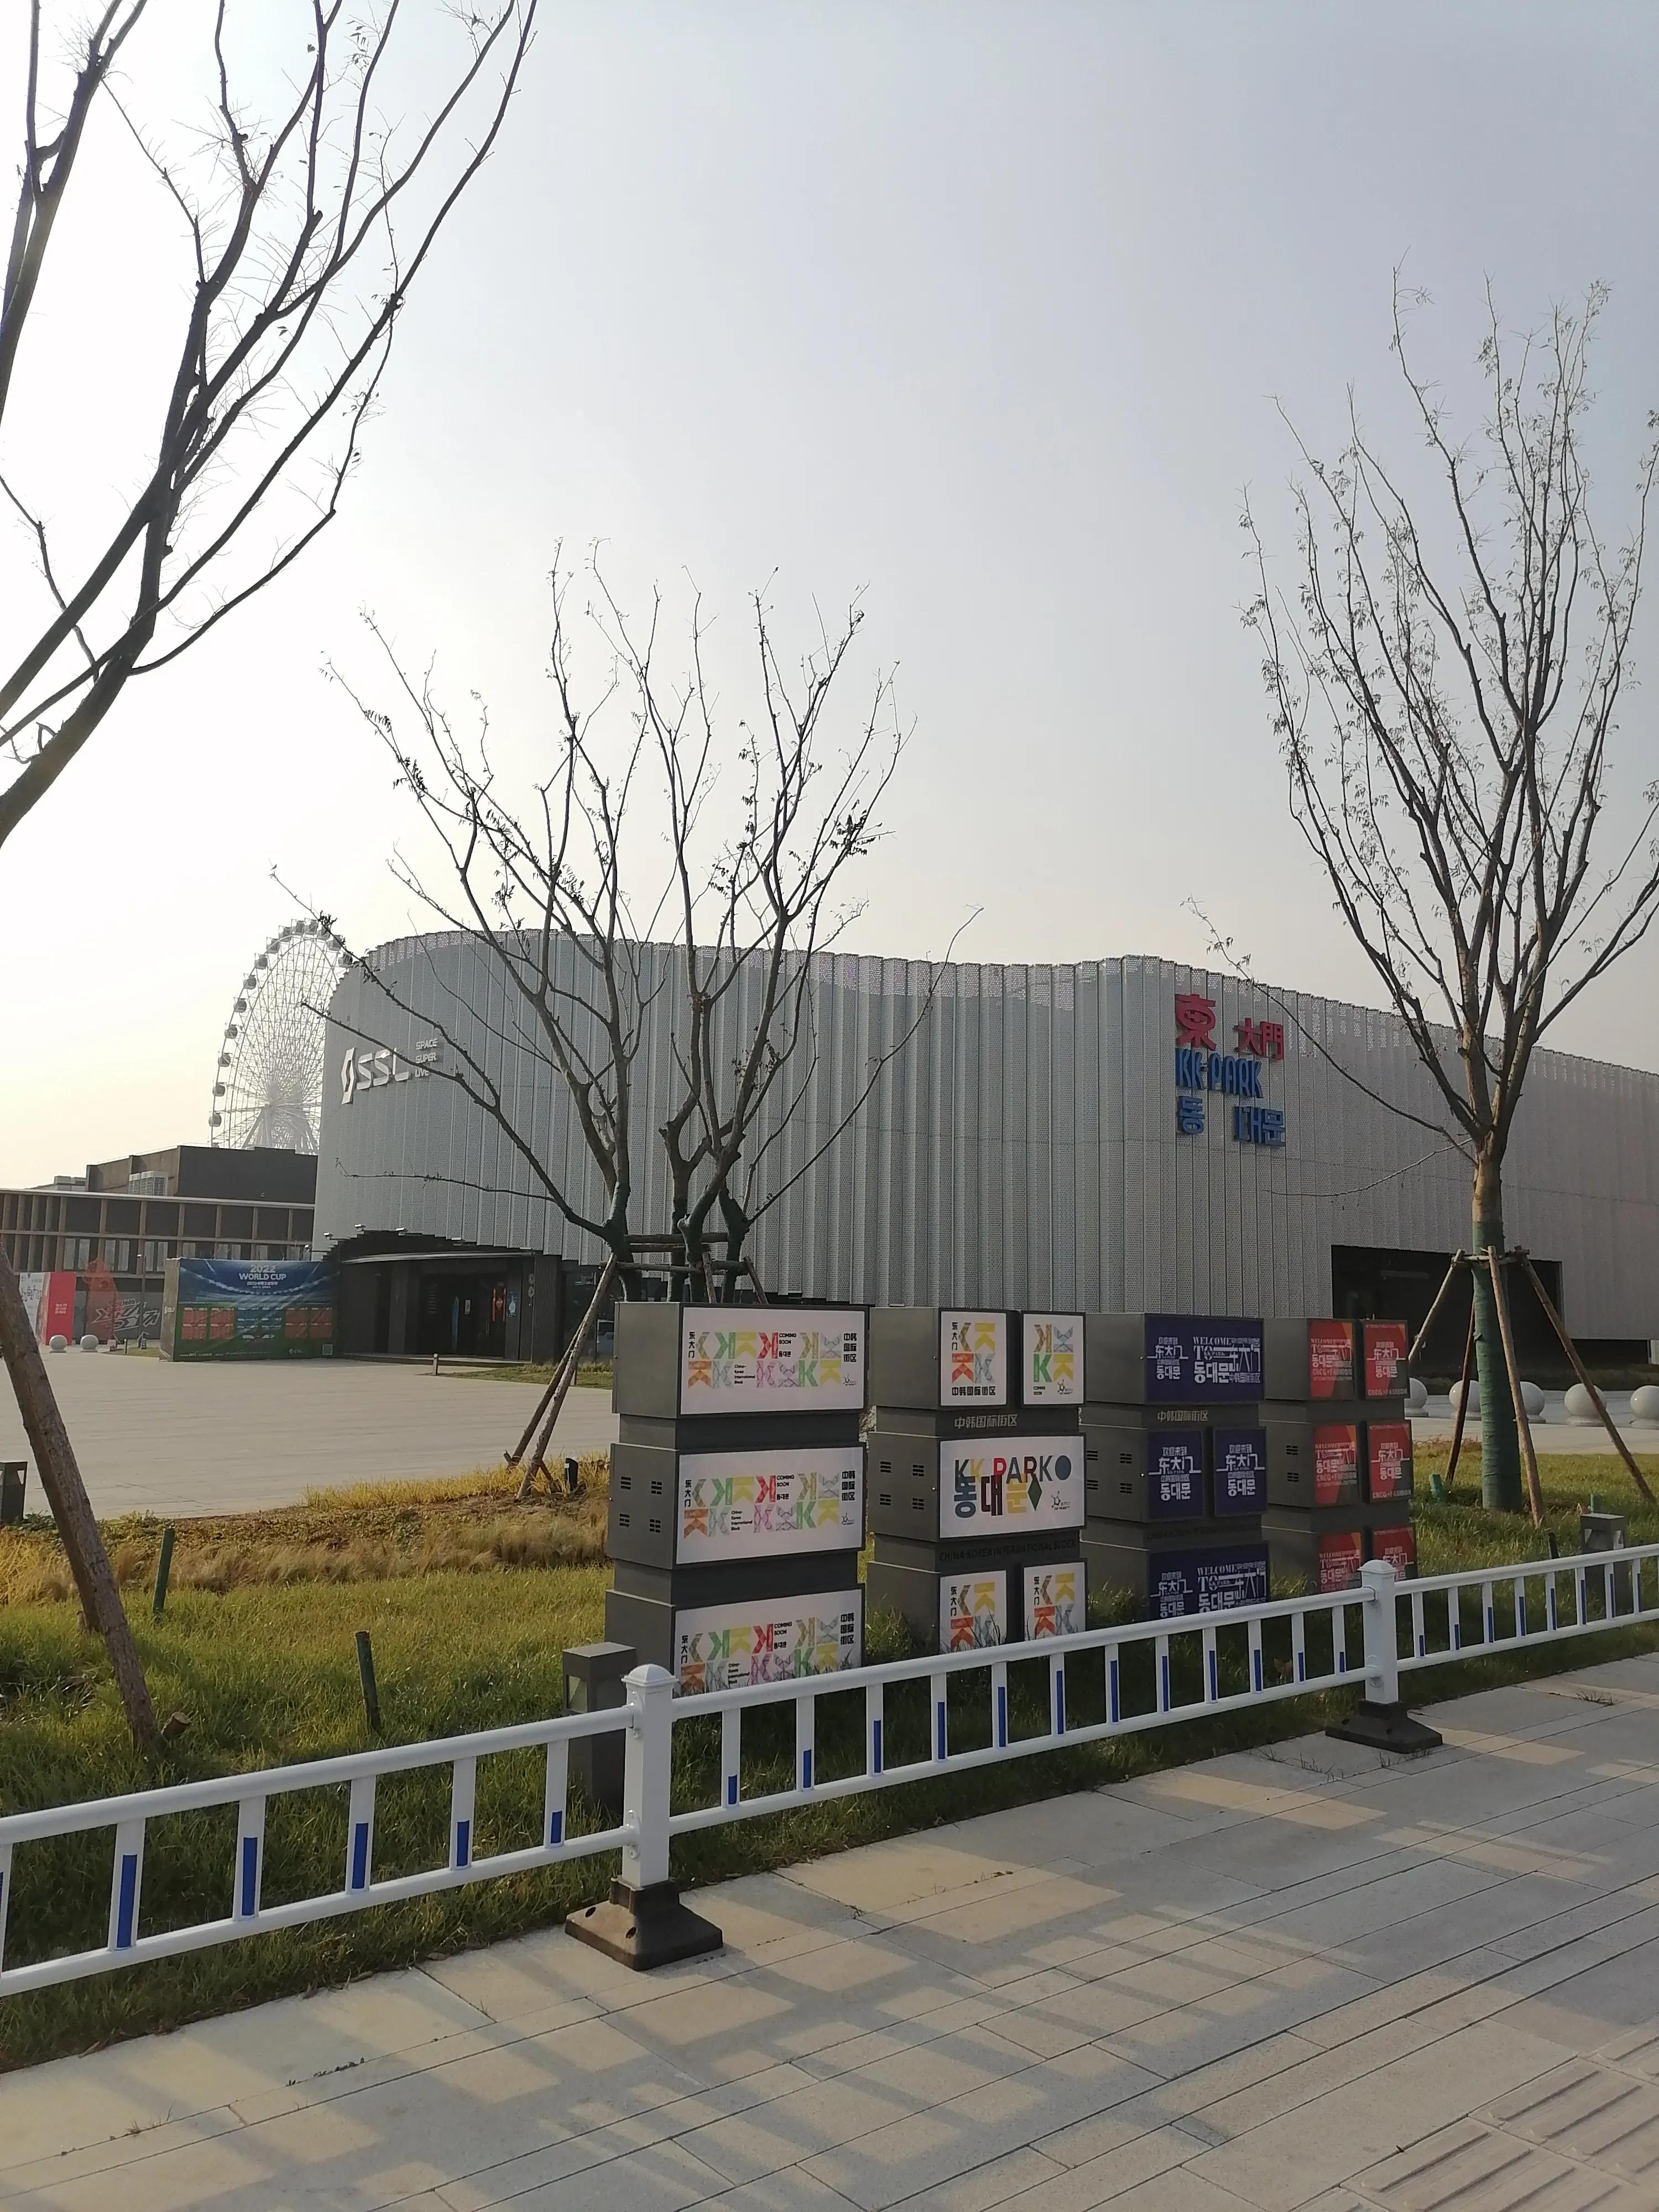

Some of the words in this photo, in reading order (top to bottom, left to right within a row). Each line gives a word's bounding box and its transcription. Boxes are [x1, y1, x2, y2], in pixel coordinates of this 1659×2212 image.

[1175, 994, 1216, 1050] 東
[1233, 1018, 1284, 1061] 大門
[415, 1038, 438, 1050] SPACE
[415, 1052, 436, 1064] SUPER
[250, 1265, 276, 1273] 2022
[1193, 1337, 1230, 1345] WELCOME
[1156, 1365, 1181, 1380] 동대문
[1194, 1361, 1229, 1383] 동대문
[1375, 1365, 1398, 1378] 동대문
[952, 1386, 996, 1396] 中韩国际街区
[954, 1414, 1018, 1430] 中韩国际街区
[1157, 1410, 1208, 1422] 中韩国际街区
[1380, 1467, 1402, 1480] 동대문
[1161, 1482, 1191, 1501] 동대문
[1228, 1479, 1256, 1496] 동대문
[1197, 1564, 1237, 1576] WELCOME
